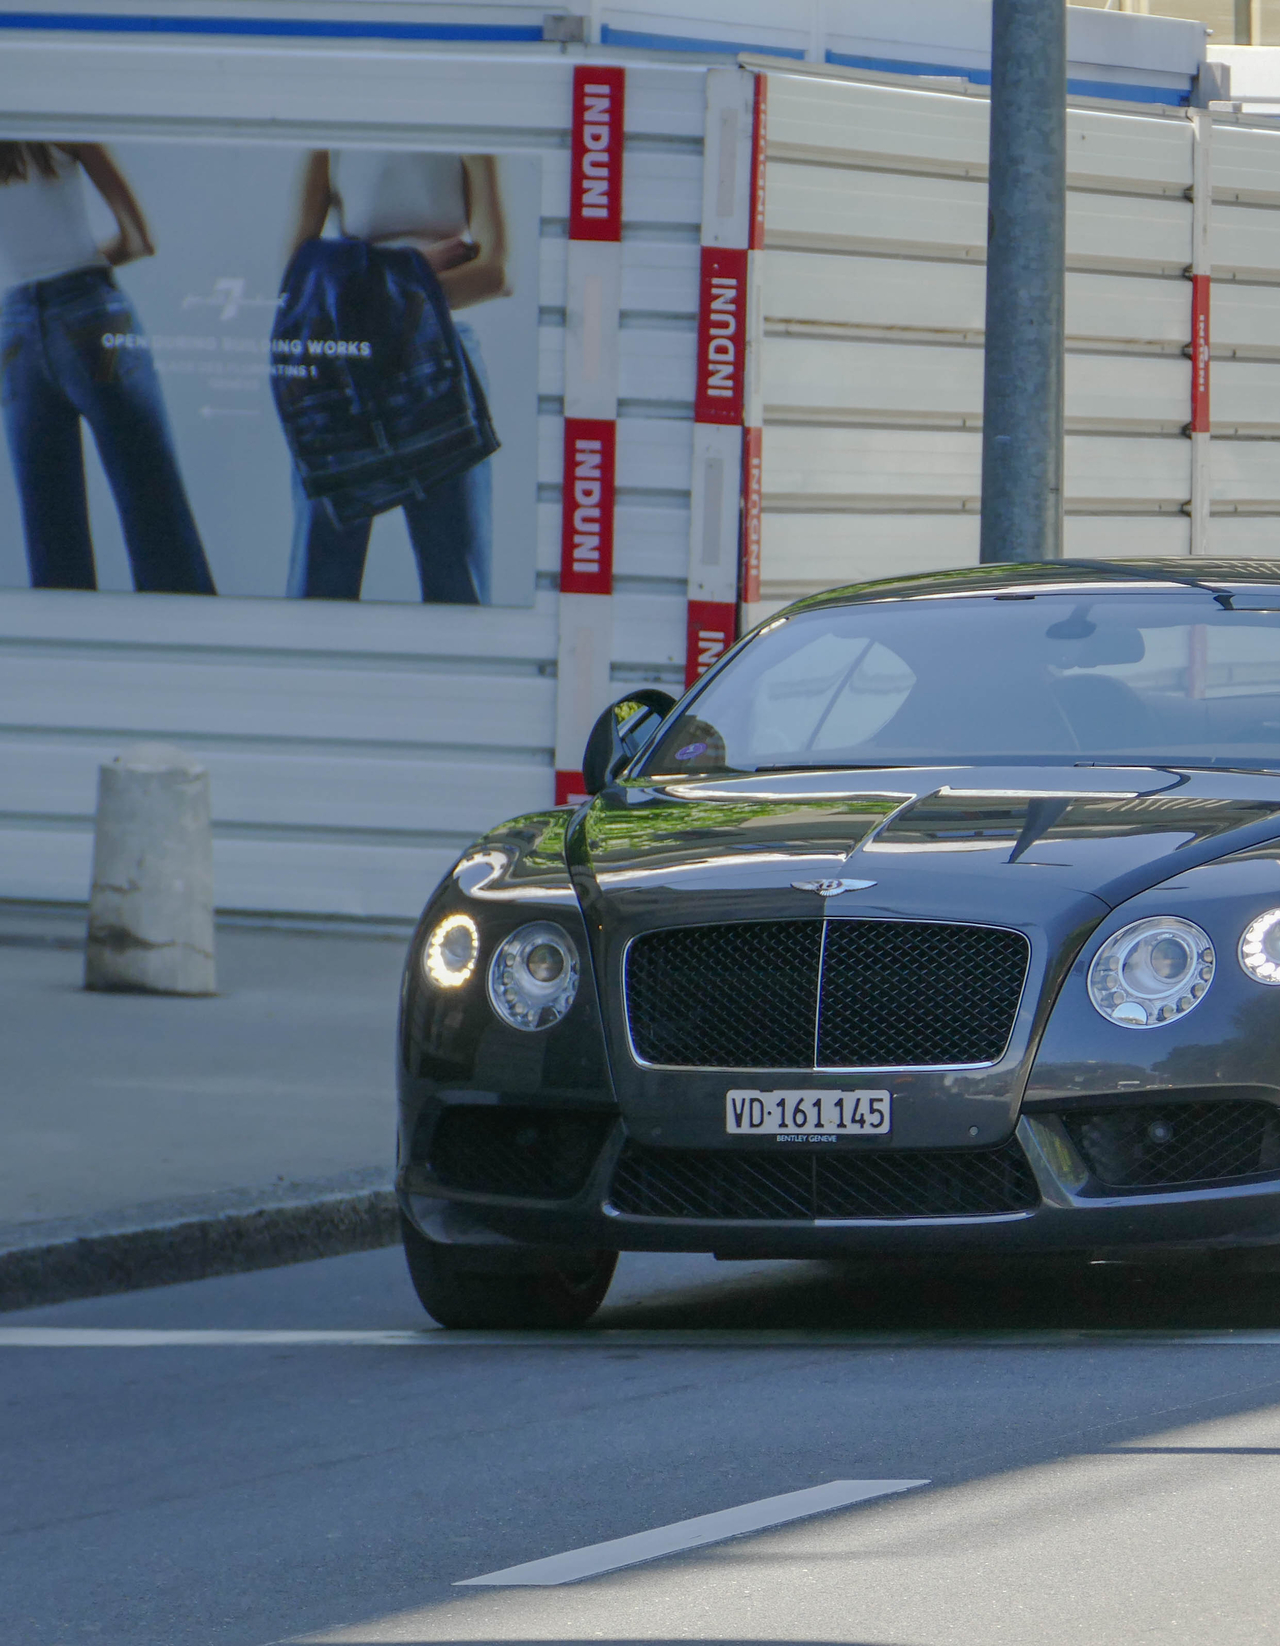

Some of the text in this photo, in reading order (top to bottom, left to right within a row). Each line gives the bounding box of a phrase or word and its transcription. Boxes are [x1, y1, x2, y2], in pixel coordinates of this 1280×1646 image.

[582, 84, 610, 219] INDUNI
[102, 332, 148, 349] OPEN
[306, 339, 372, 357] WORKS
[707, 277, 738, 397] INDUNI
[573, 439, 602, 573] INDUNI
[776, 1134, 808, 1142] BENTLEY
